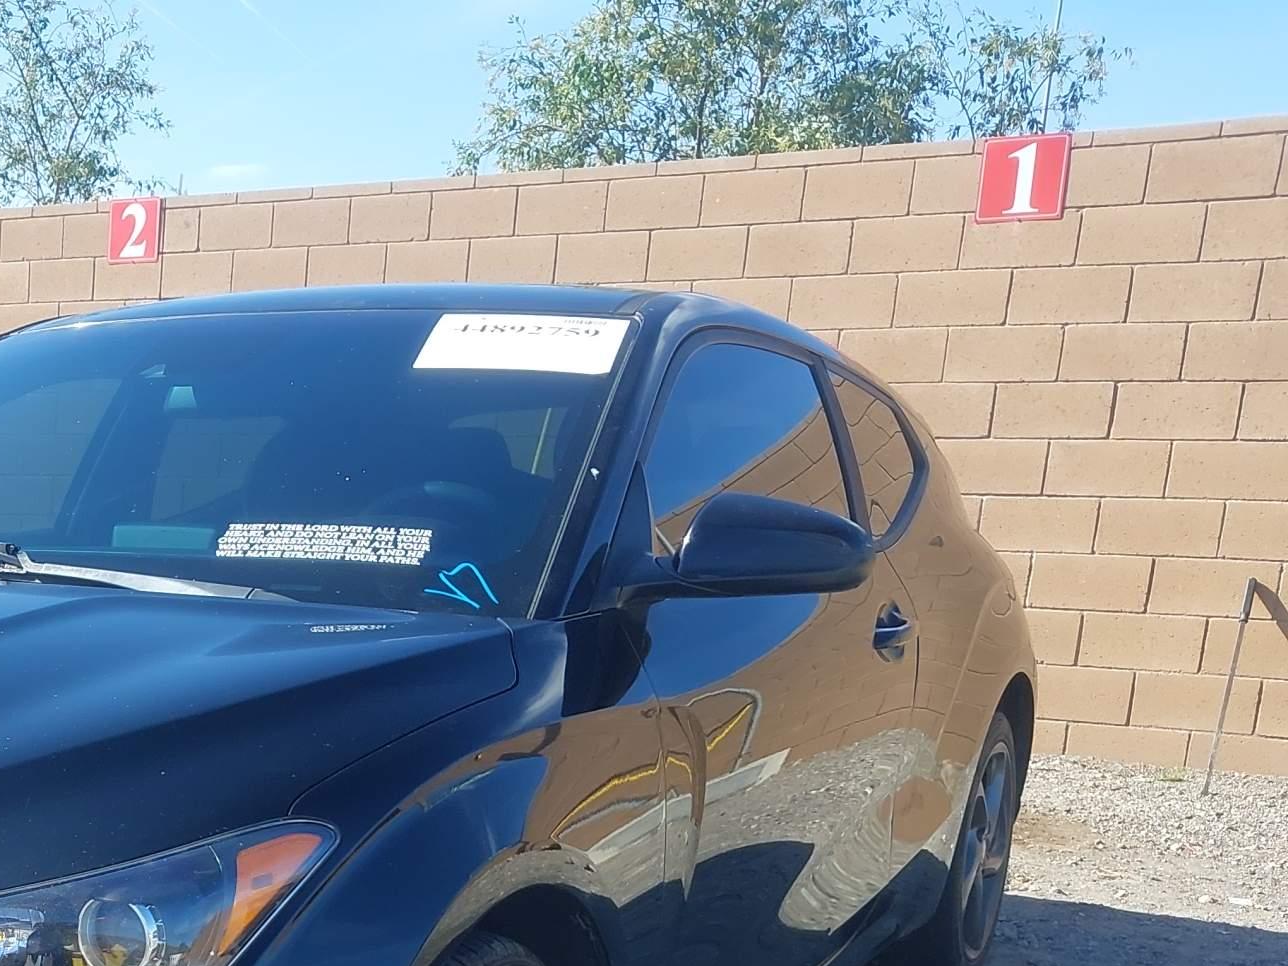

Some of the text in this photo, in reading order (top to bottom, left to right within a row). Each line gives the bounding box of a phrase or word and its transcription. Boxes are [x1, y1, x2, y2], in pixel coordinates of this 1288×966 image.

[1001, 143, 1040, 214] 1
[119, 203, 148, 258] 2
[452, 322, 600, 337] 44892759
[228, 523, 432, 537] TRUST IN THE LORD WITH ALL YOUR
[265, 530, 293, 538] AND
[314, 531, 341, 539] NOT
[341, 532, 374, 541] LEAN
[396, 535, 430, 544] YOUR
[218, 543, 251, 551] WAYS
[250, 543, 345, 553] ACKNOWLEDGE
[376, 548, 406, 556] AND
[406, 550, 425, 558] HE
[371, 541, 394, 549] ALL
[396, 543, 431, 552] YOUR
[245, 550, 281, 558] MAKE
[282, 551, 344, 560] STRAIGHT
[344, 554, 377, 562] YOUR
[378, 556, 421, 566] PATHS.
